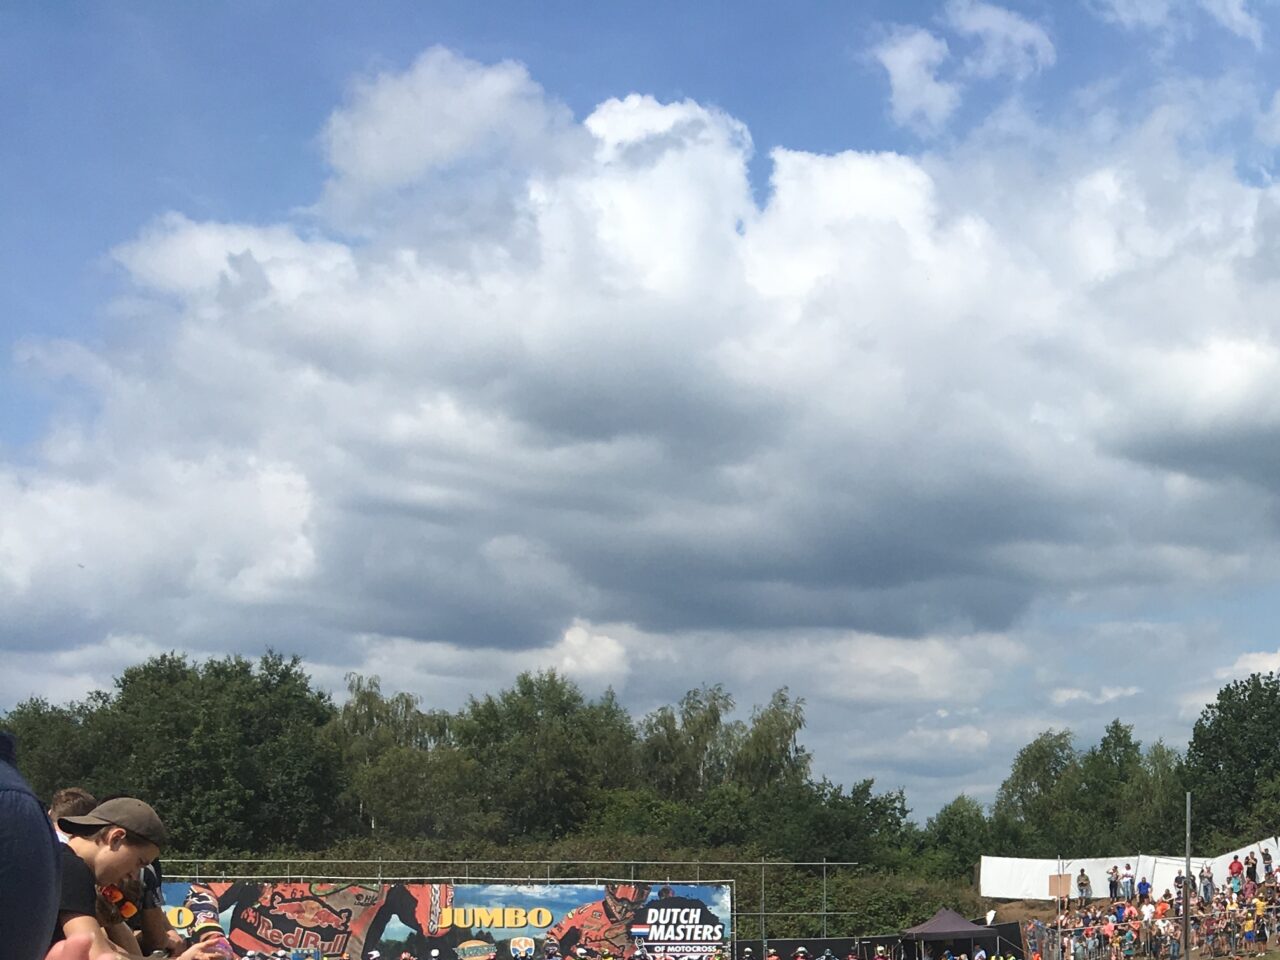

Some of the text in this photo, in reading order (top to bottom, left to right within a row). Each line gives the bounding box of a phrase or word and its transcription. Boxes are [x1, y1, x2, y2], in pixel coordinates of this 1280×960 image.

[437, 907, 553, 928] JUMBO
[647, 908, 701, 924] DUTCH
[257, 915, 347, 954] Red Bull
[648, 925, 722, 940] MASTERS
[667, 945, 717, 953] MOTOCROSS
